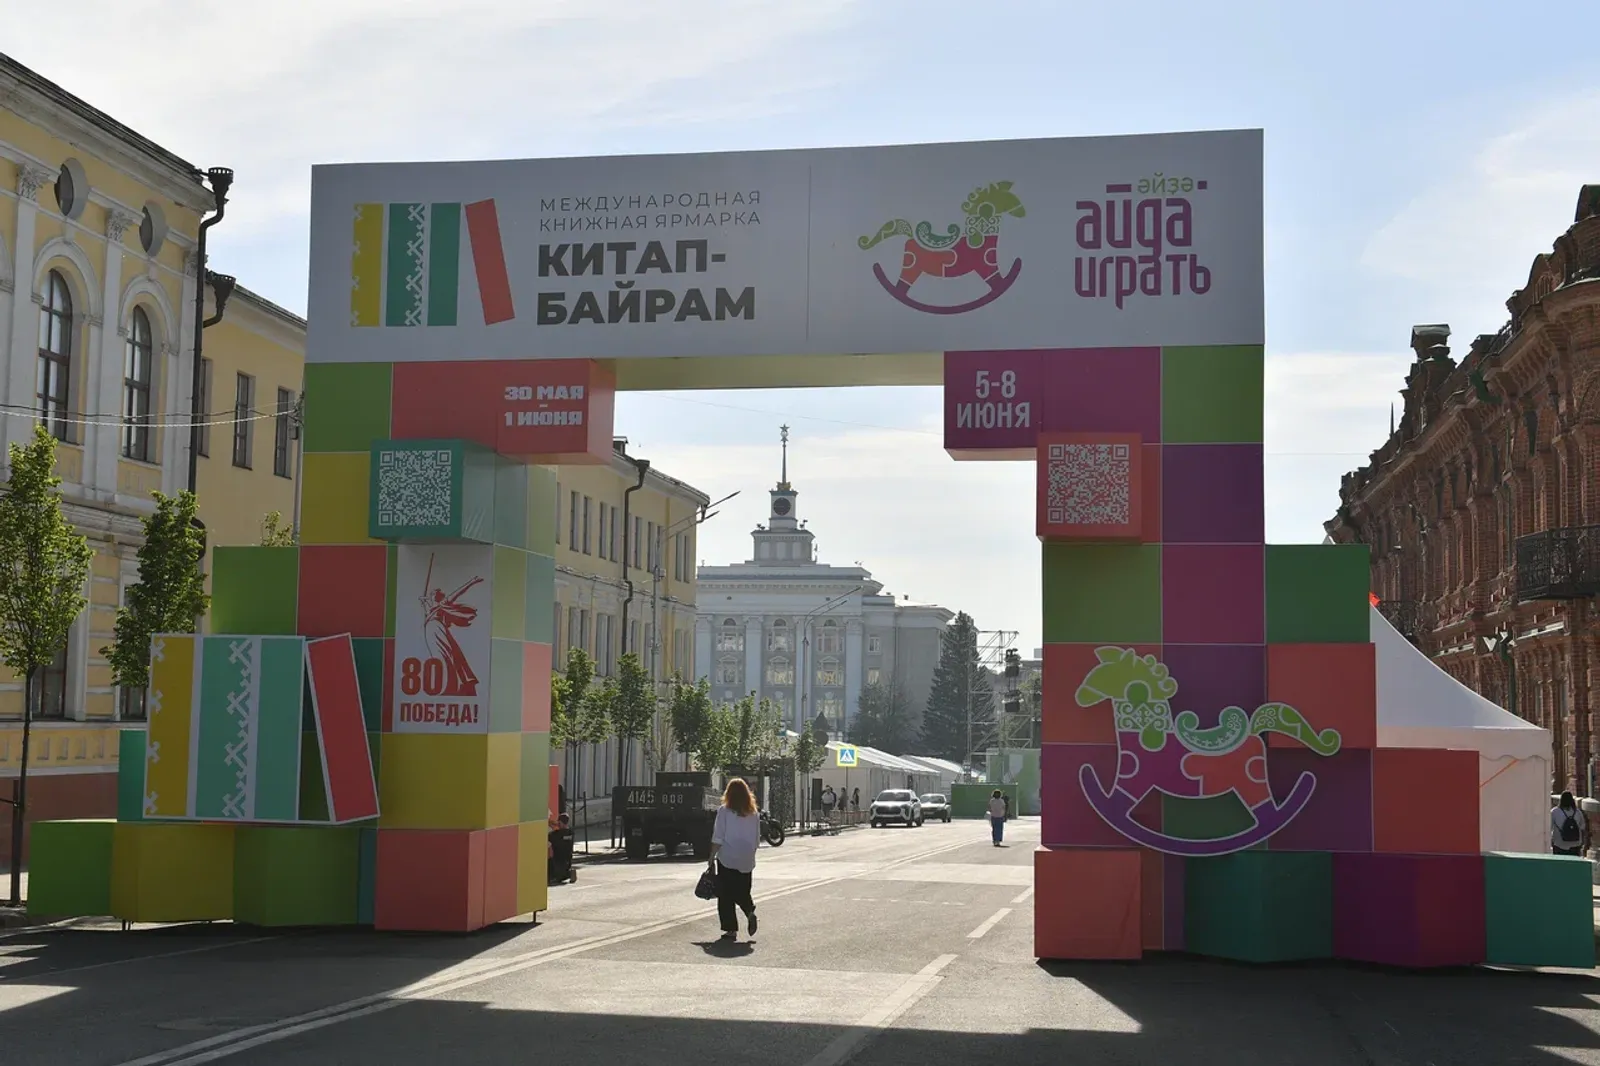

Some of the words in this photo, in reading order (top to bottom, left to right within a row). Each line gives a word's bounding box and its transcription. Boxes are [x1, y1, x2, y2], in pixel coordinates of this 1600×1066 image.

[540, 190, 761, 212] МЕЖДУНАРОДНАЯ
[540, 215, 647, 232] КНИЖНАЯ
[655, 211, 761, 228] ЯРМАРКА
[537, 239, 726, 277] КИТАП-
[1074, 254, 1211, 310] играть
[536, 280, 755, 326] БАЙРАМ
[504, 386, 532, 400] 30
[536, 385, 584, 400] МАЯ
[975, 370, 1016, 399] 5-8
[504, 411, 513, 426] 1
[517, 411, 583, 426] ИЮНЯ
[956, 402, 1031, 429] ИЮНЯ
[401, 656, 444, 696] 80
[400, 703, 479, 726] ПОБЕДА!
[627, 789, 655, 804] 4145
